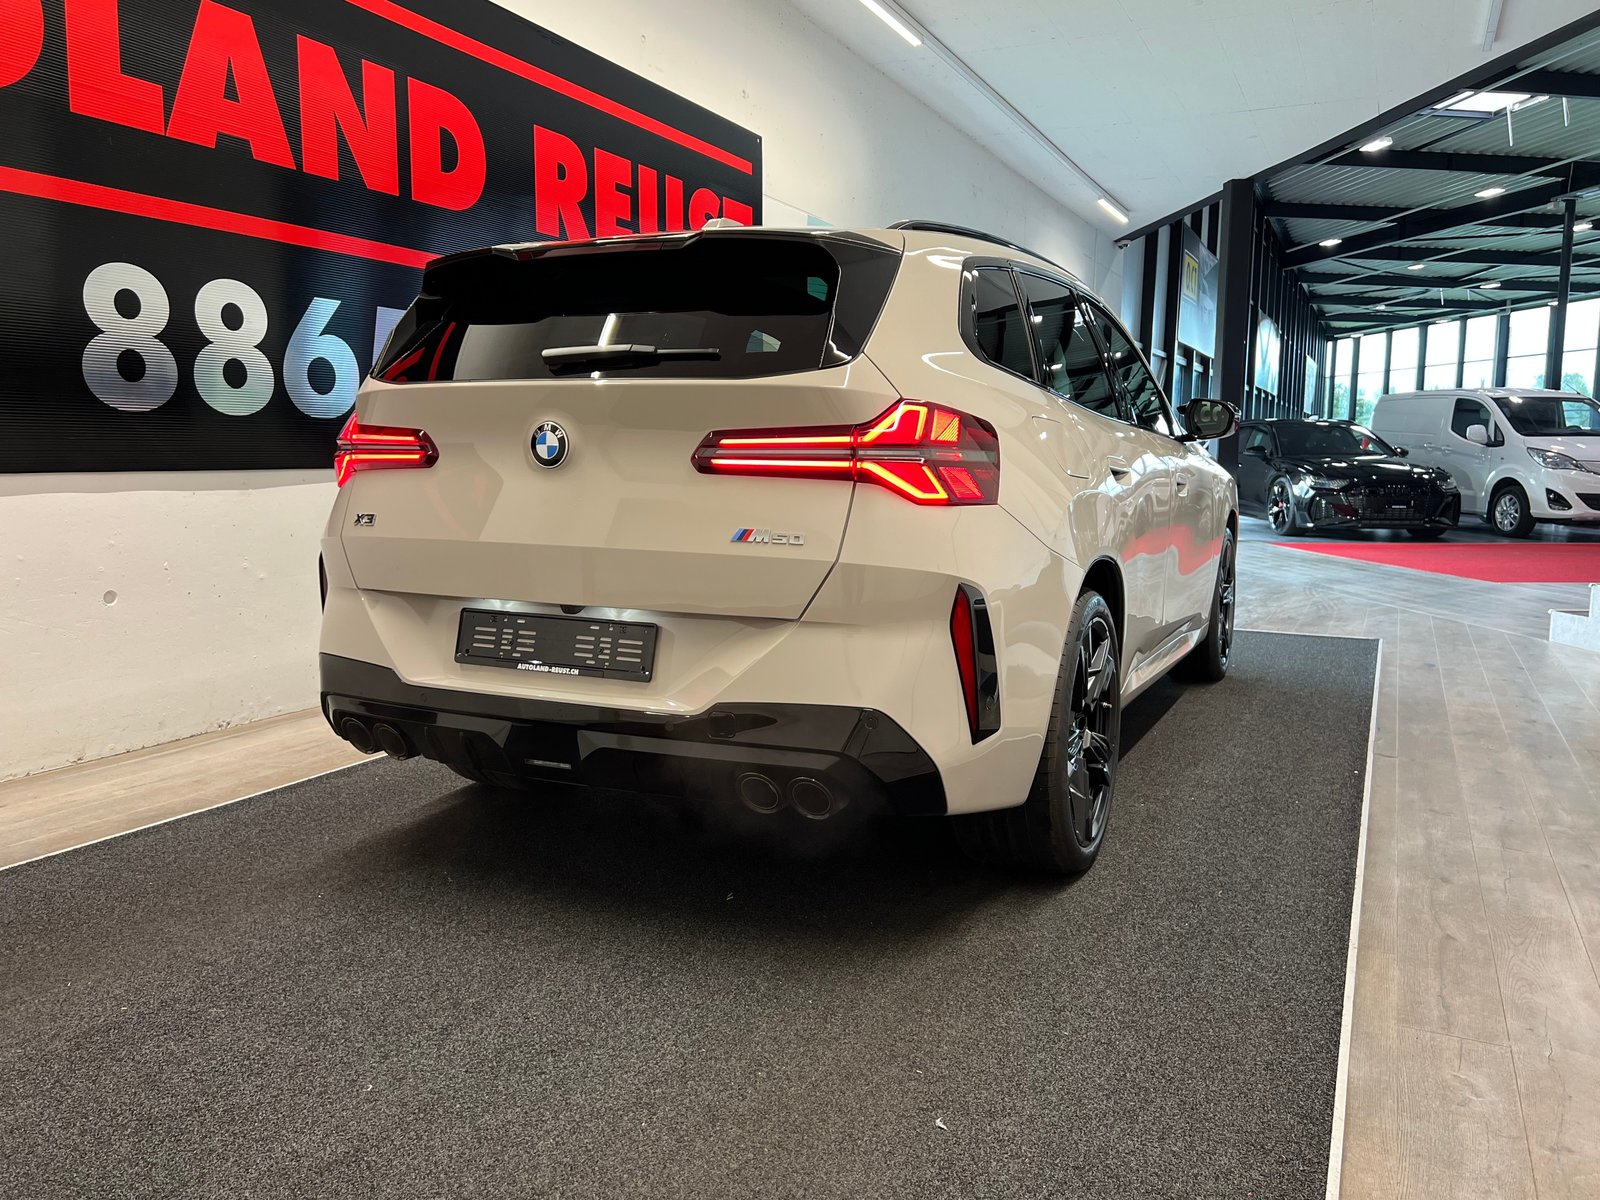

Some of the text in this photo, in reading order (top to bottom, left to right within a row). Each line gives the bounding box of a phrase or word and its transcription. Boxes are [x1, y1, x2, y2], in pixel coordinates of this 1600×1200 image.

[533, 423, 564, 439] BMW
[353, 513, 376, 527] X3
[517, 663, 579, 675] AUTOLAND-REUST.CH
